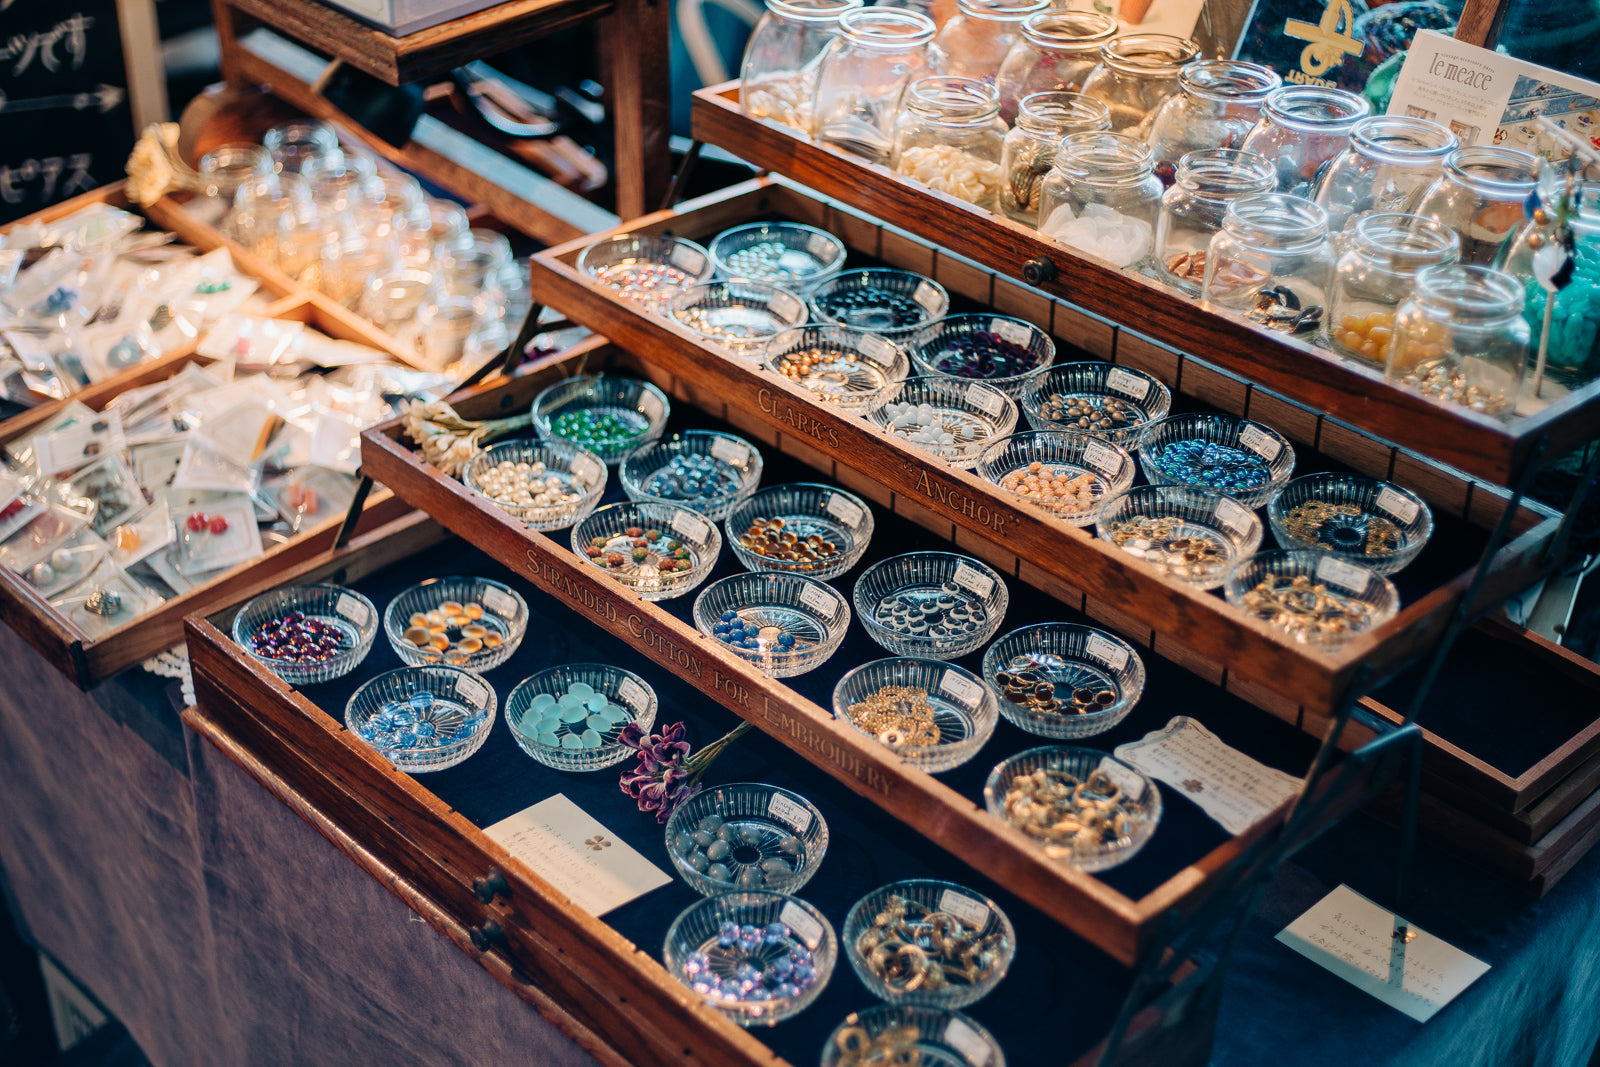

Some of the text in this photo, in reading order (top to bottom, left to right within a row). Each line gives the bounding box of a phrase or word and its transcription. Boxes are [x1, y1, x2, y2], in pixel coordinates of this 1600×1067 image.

[1428, 52, 1493, 91] le meace
[0, 152, 99, 204] ピアス
[757, 388, 840, 449] CLARK'S
[525, 549, 618, 623] STRANDED
[627, 613, 704, 679] COTTON
[713, 669, 751, 710] FOR
[763, 696, 895, 797] EMBROIDERY
